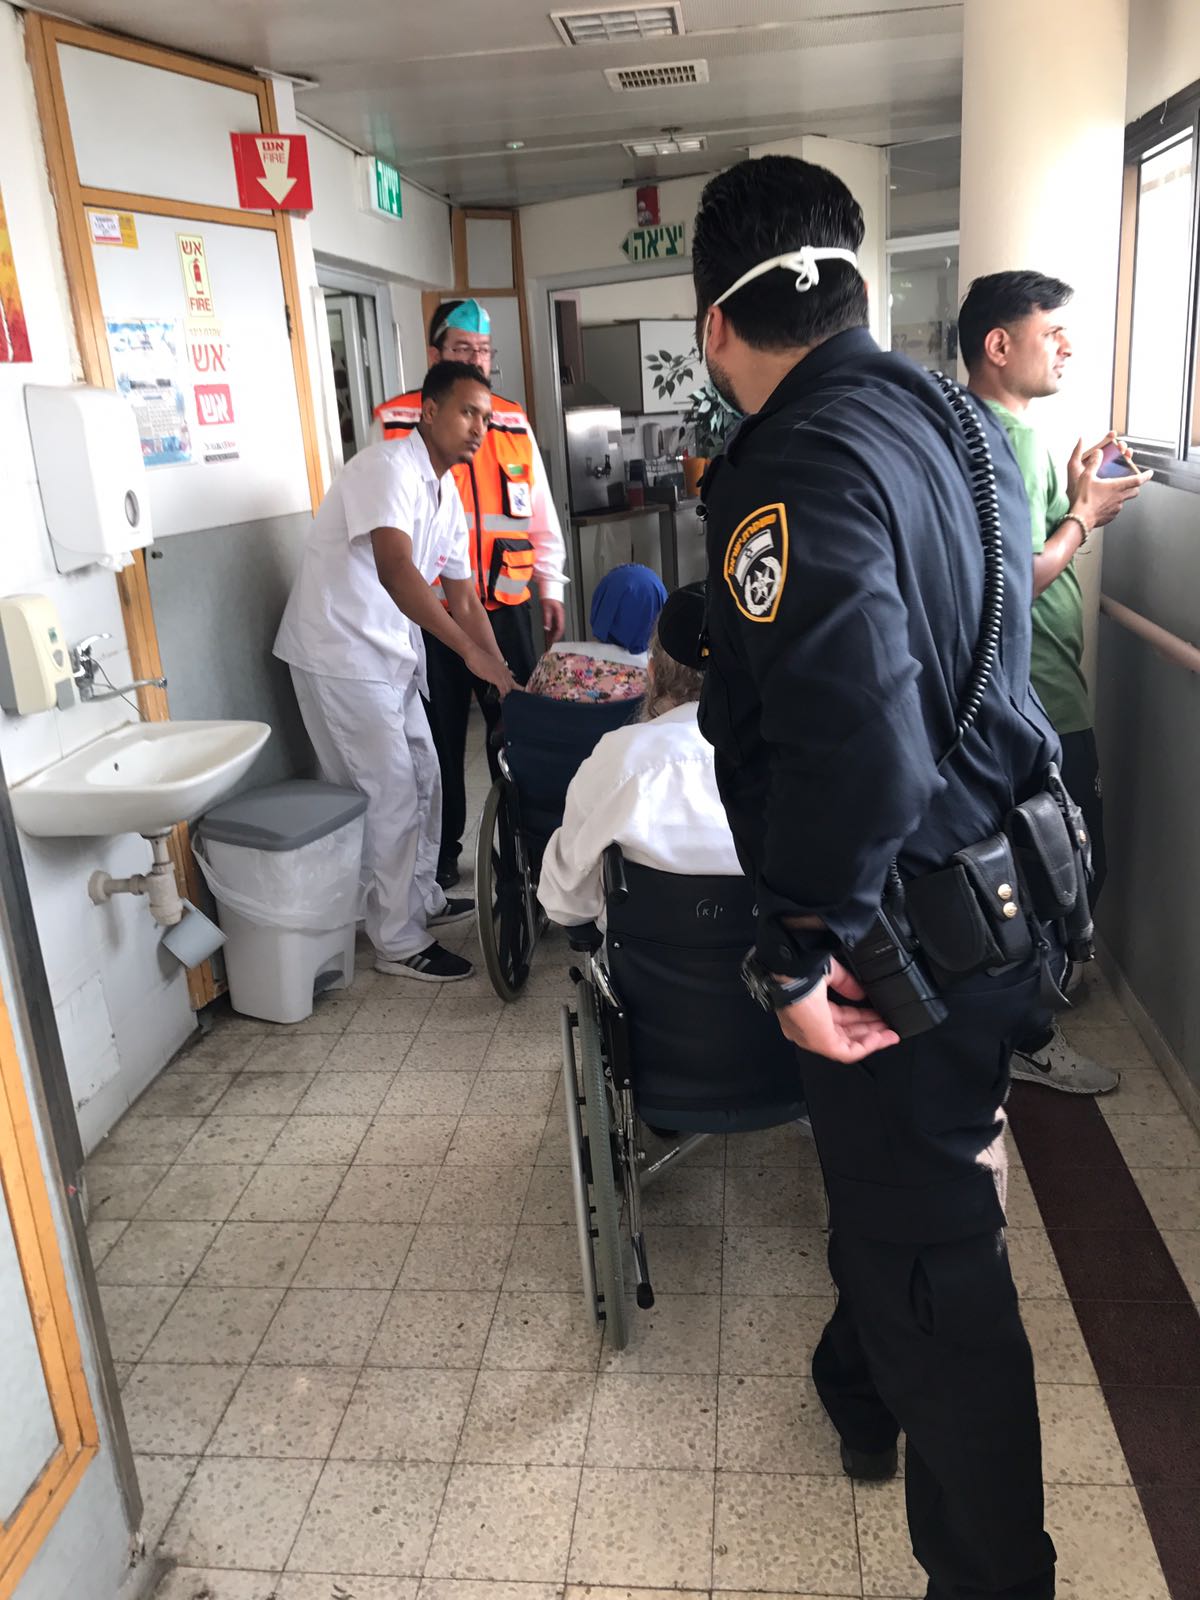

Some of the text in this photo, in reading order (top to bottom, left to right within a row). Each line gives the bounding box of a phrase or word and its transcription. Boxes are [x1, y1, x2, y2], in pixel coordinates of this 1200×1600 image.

[262, 141, 284, 151] אש
[263, 152, 286, 164] FIRE
[181, 239, 202, 257] אש
[633, 225, 682, 260] יציאה
[190, 297, 212, 312] FIRE
[192, 343, 226, 372] אש
[200, 392, 230, 424] אש
